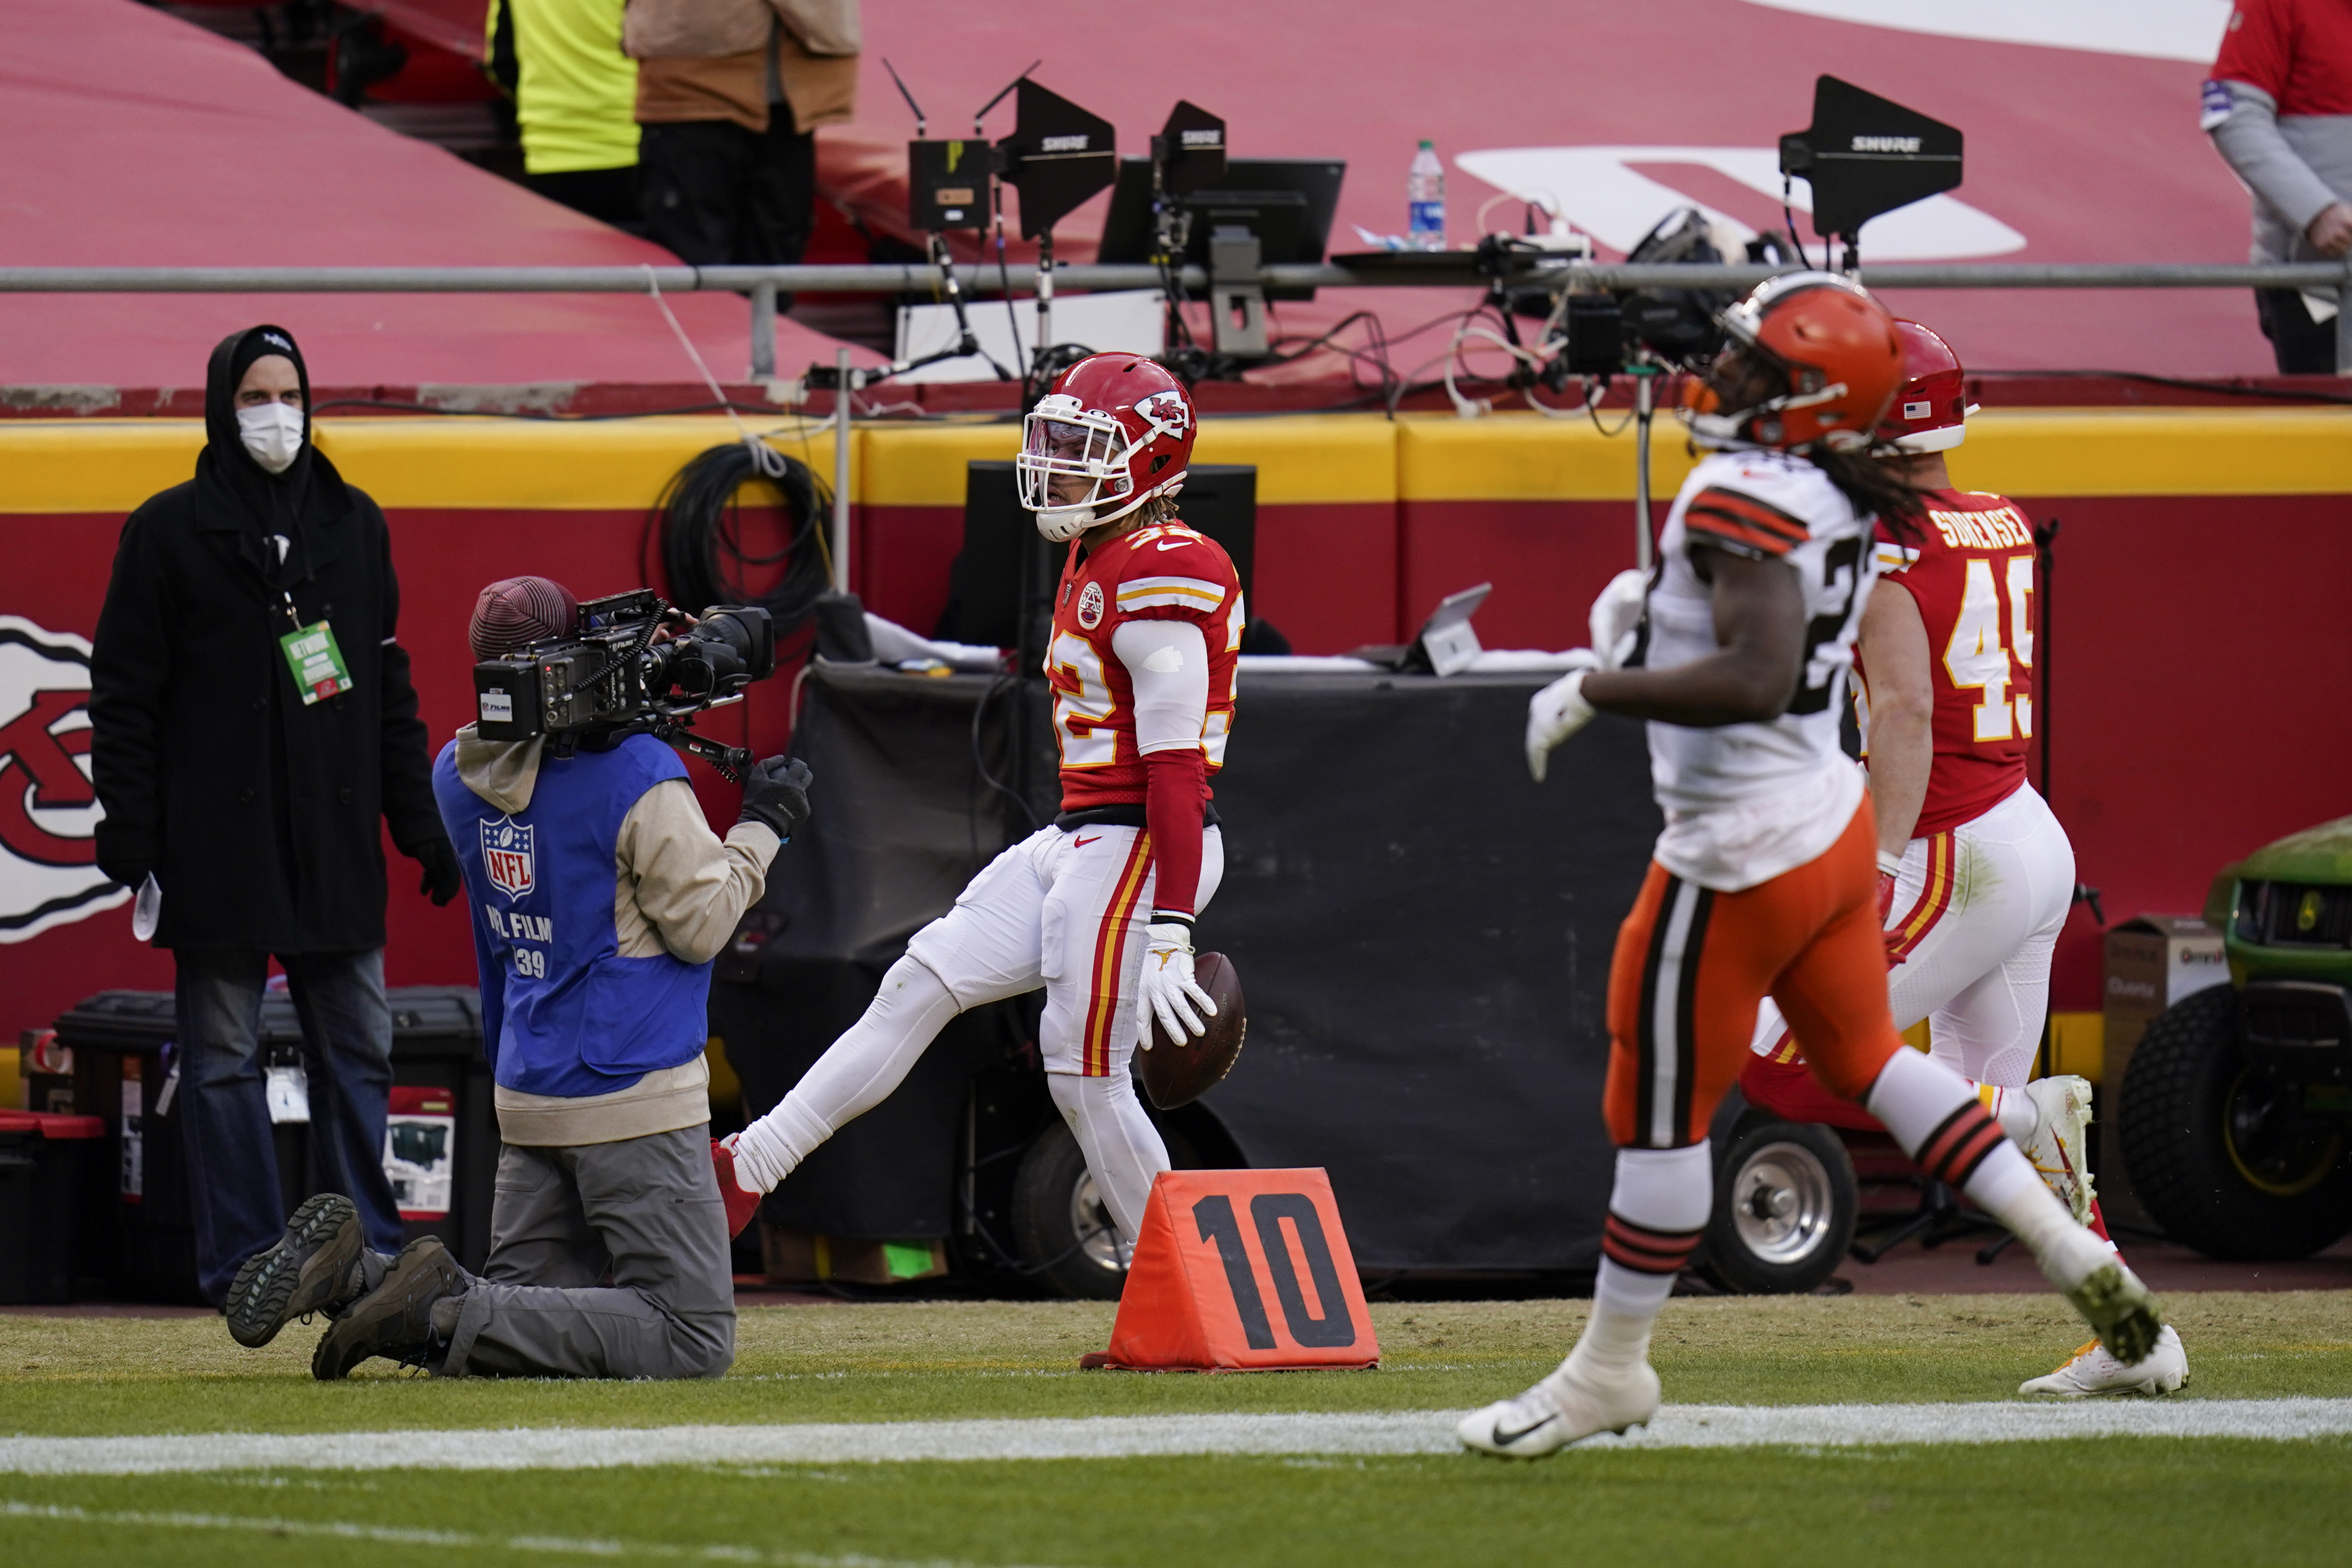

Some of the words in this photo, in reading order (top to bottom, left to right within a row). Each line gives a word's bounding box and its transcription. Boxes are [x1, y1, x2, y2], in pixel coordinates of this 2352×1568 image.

[1041, 135, 1090, 152] SHURE
[1182, 130, 1222, 144] SHURE
[1851, 135, 1924, 153] SHURE
[488, 850, 531, 888] NFL
[1192, 1193, 1356, 1350] 10
